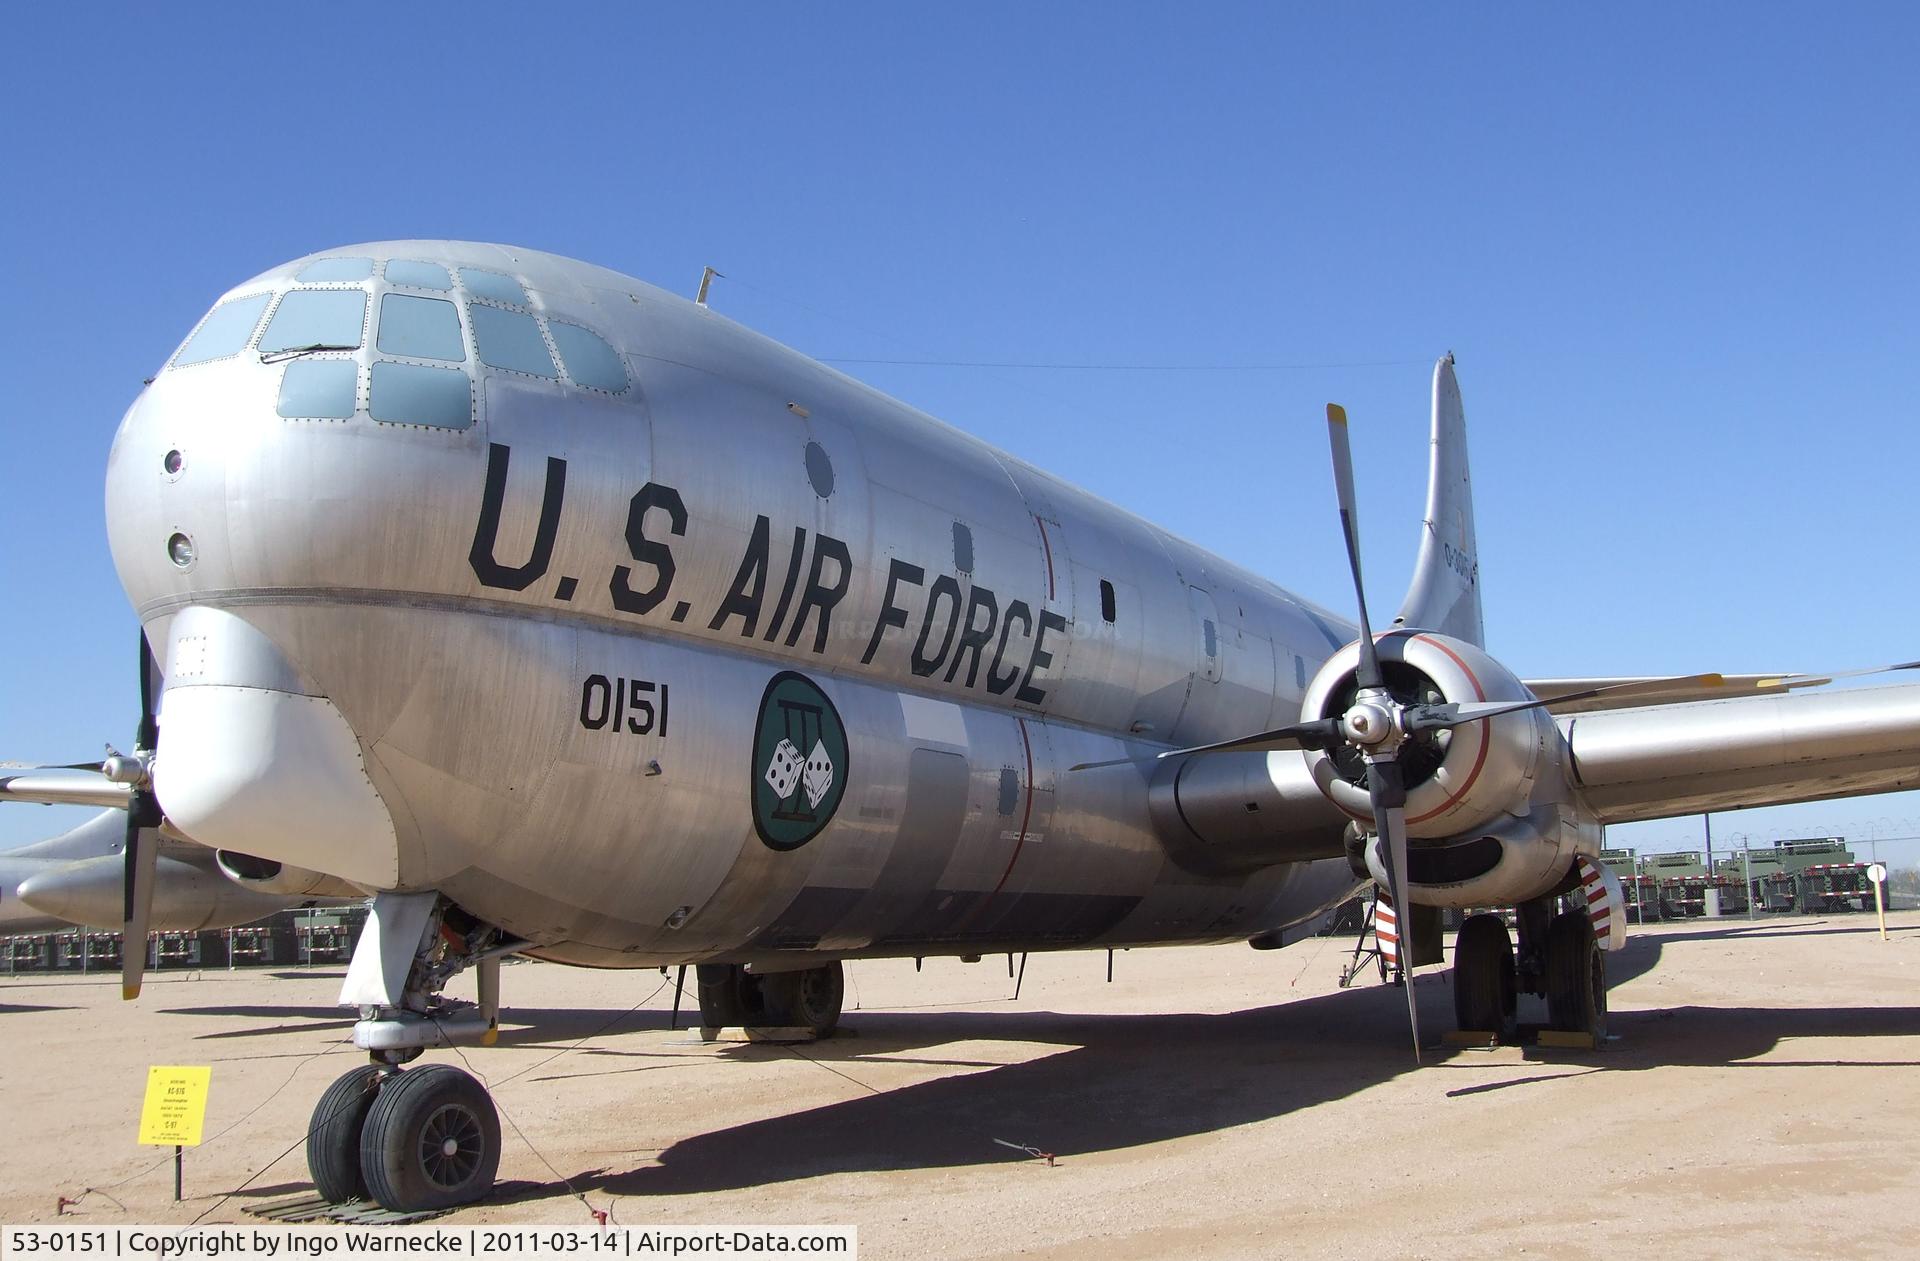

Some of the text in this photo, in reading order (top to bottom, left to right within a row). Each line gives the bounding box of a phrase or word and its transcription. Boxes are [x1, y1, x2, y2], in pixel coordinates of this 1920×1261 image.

[468, 442, 1066, 705] U.S. AIR FORCE
[579, 673, 669, 738] 0151
